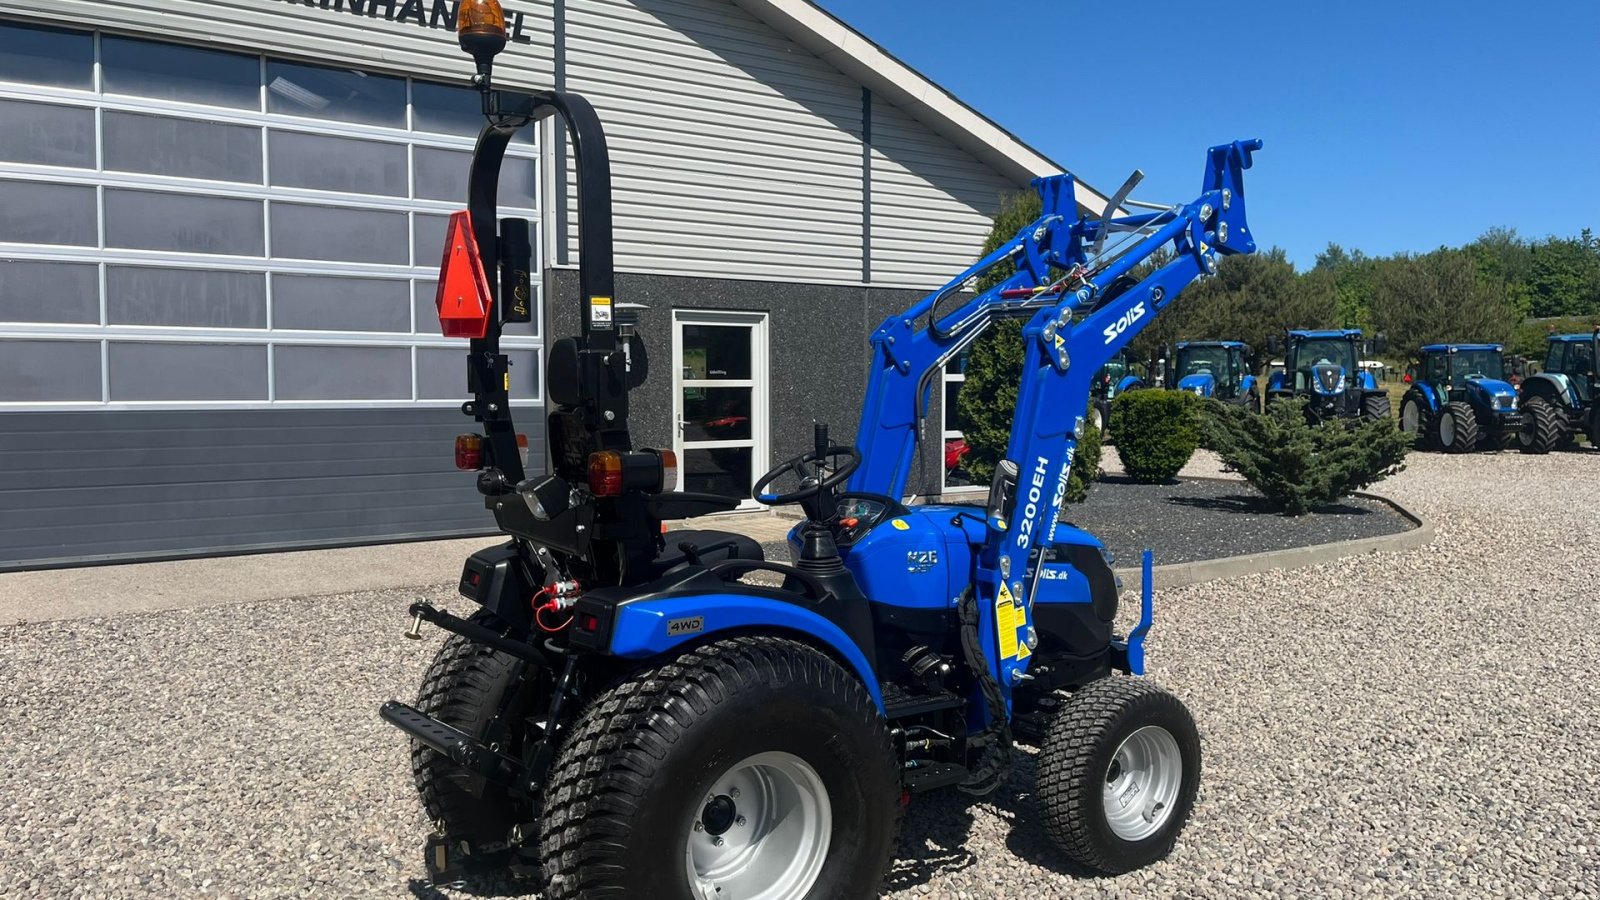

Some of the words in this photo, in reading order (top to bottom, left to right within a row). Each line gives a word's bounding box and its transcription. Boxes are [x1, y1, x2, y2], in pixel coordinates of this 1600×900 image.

[1103, 301, 1146, 345] Solis
[1017, 456, 1049, 549] 3200EH
[1048, 446, 1075, 541] www.Solis.dk
[671, 619, 700, 631] 4WD
